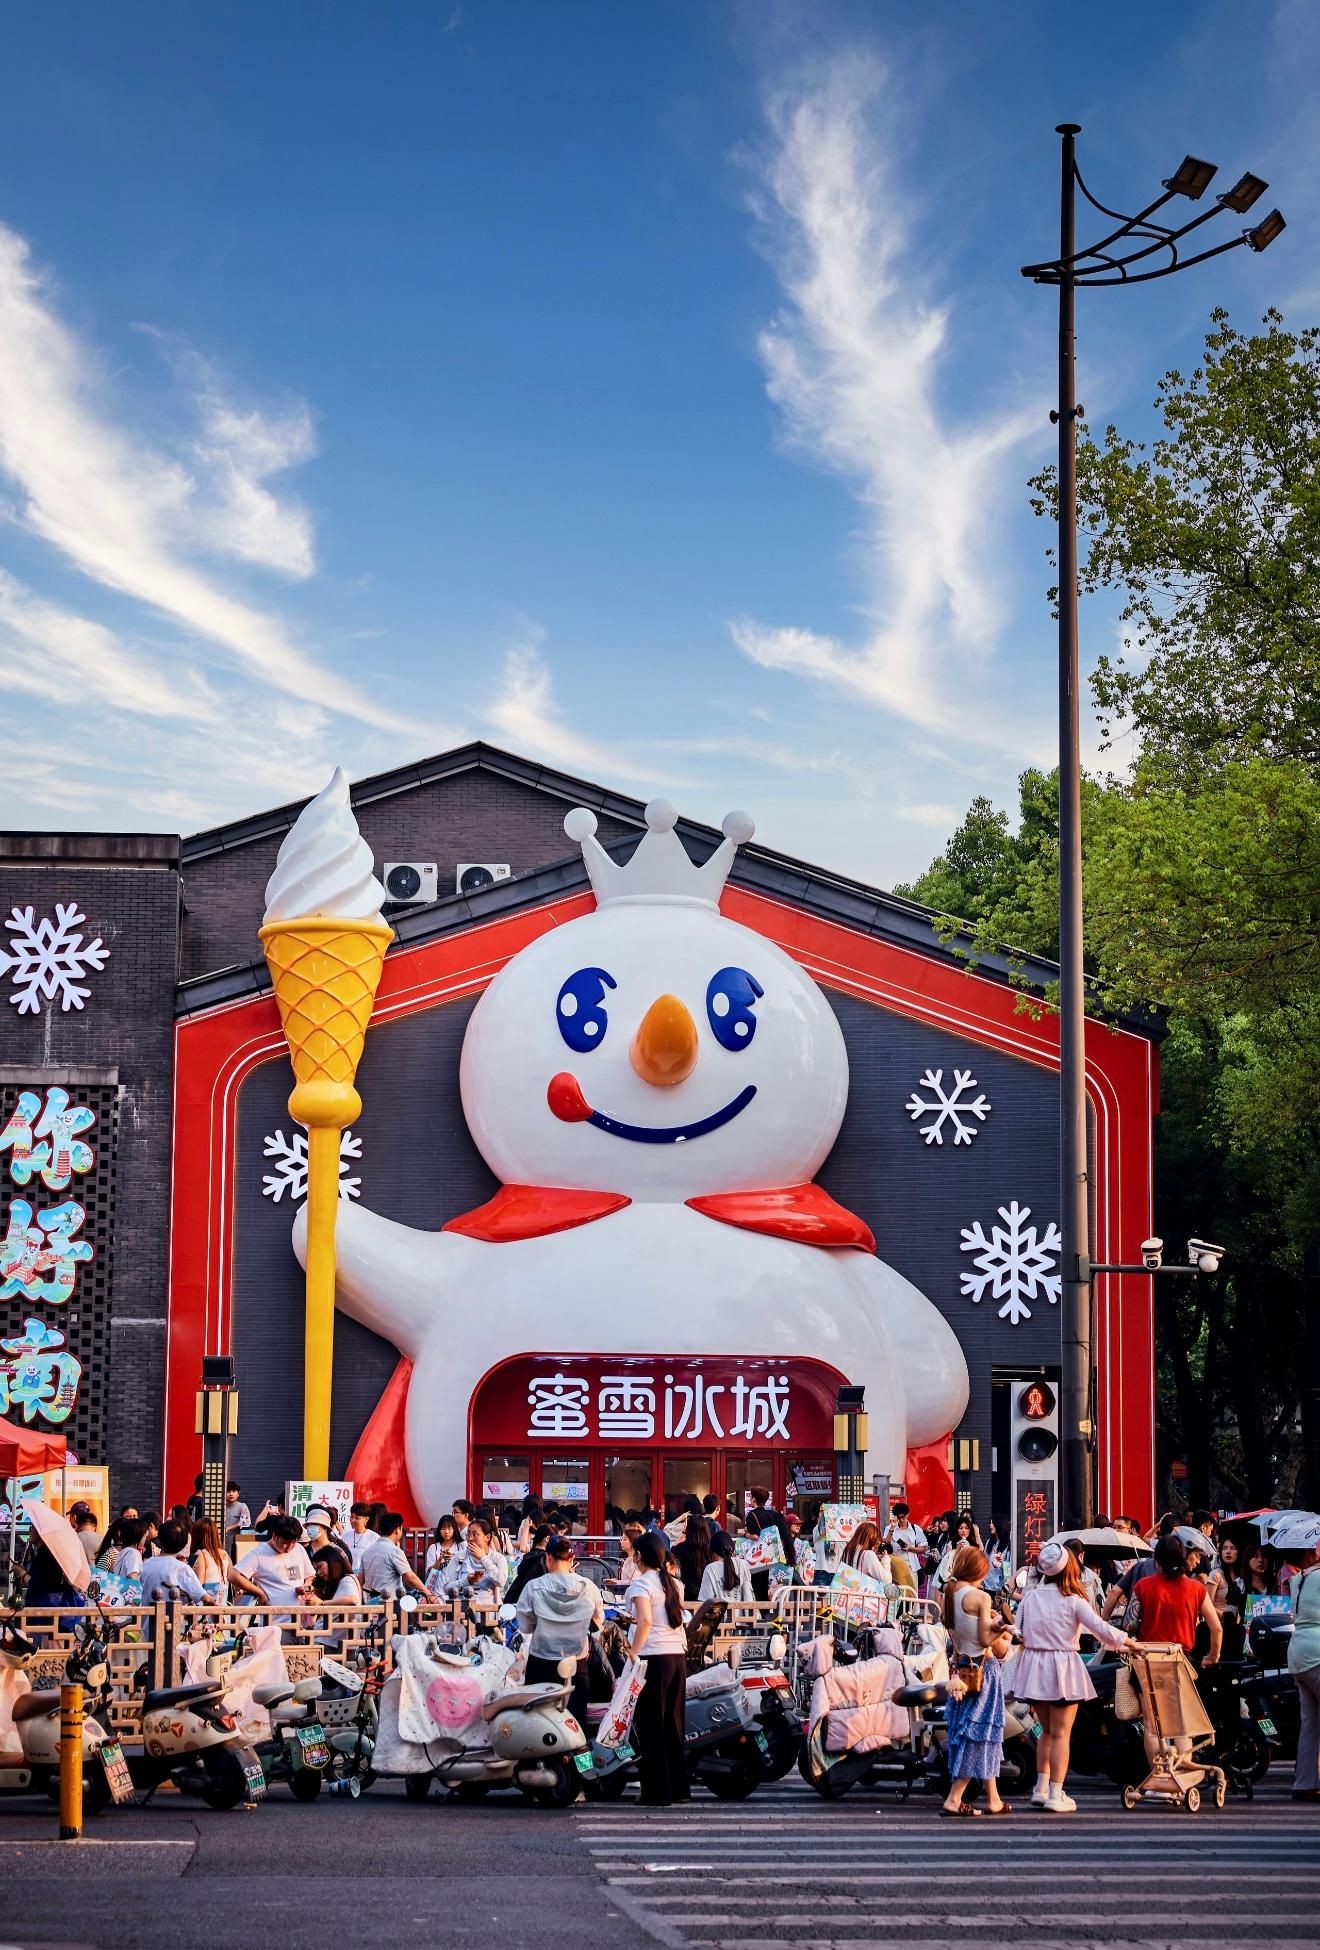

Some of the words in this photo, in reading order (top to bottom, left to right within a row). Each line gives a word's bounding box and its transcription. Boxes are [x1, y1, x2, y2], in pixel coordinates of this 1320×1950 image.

[0, 1084, 97, 1542] 你好南
[527, 1373, 790, 1440] 蜜雪冰城
[1024, 1492, 1047, 1566] 绿灯亮
